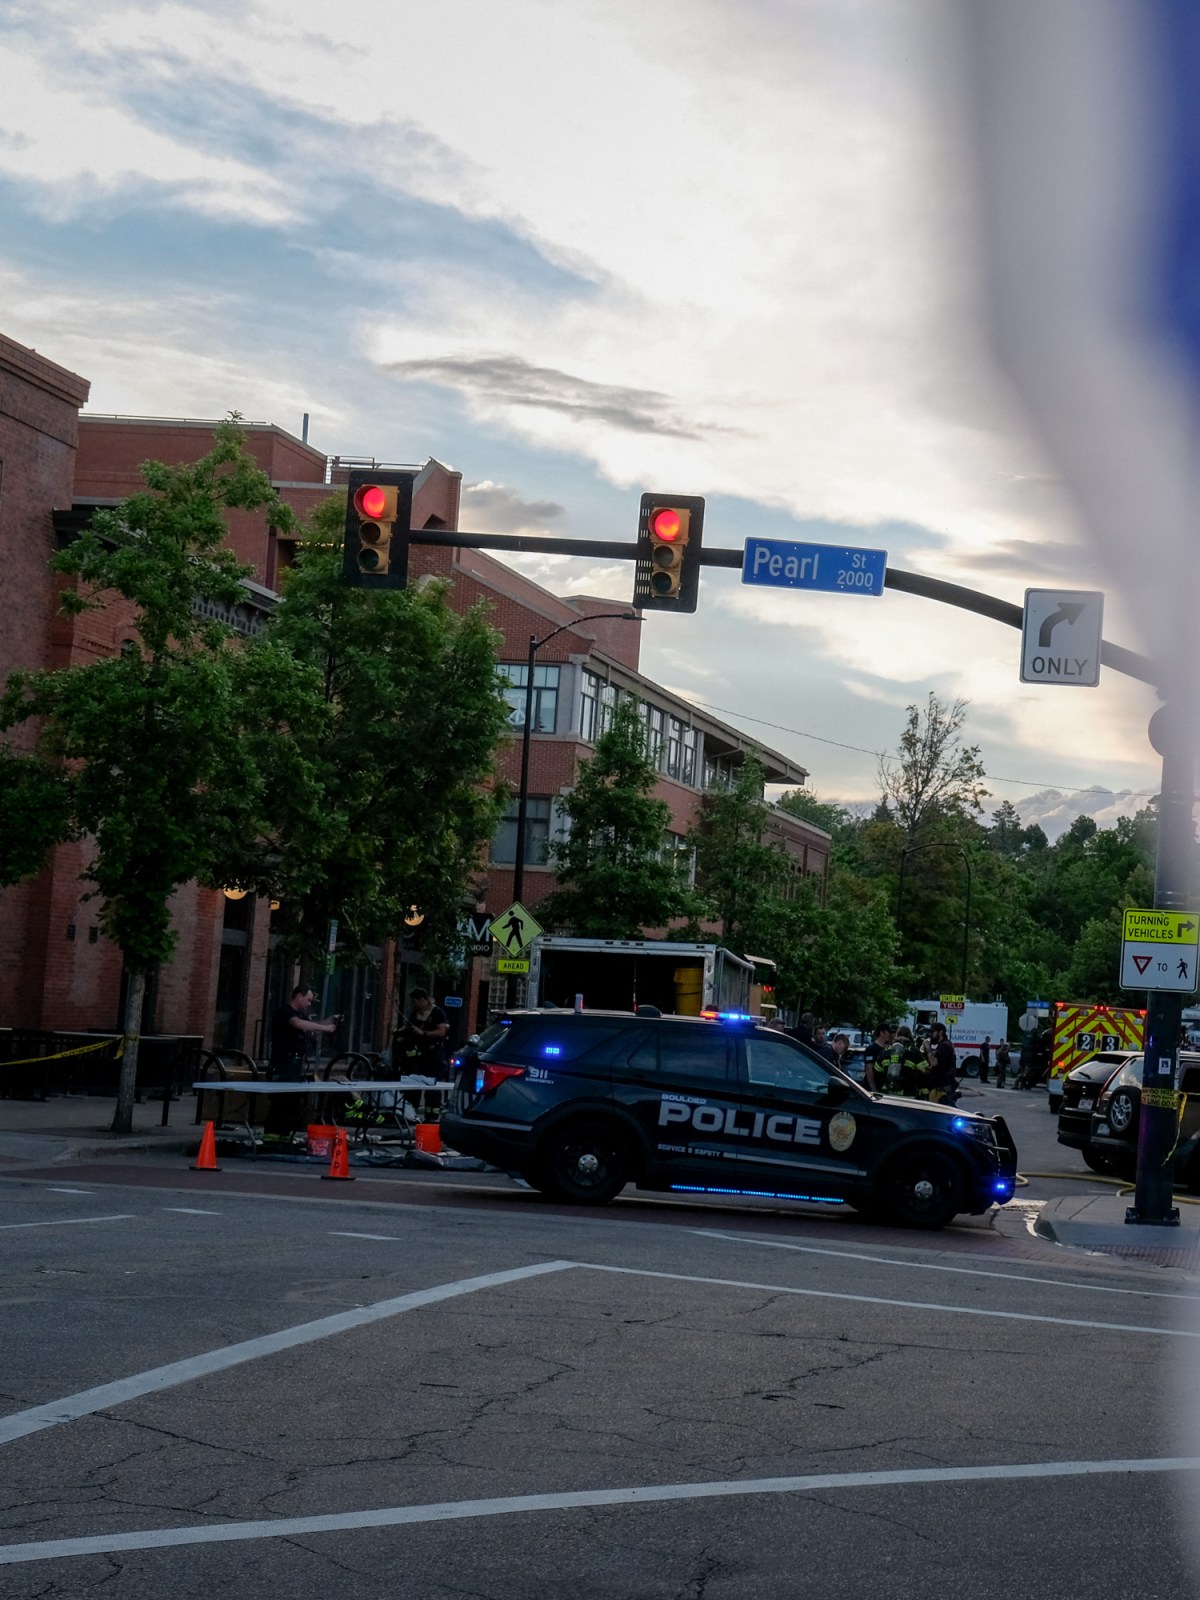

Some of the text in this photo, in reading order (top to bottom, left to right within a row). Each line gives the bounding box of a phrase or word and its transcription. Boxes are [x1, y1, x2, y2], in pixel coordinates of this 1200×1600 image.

[753, 547, 867, 580] Pearl St
[837, 570, 874, 587] 2000
[1032, 656, 1089, 676] ONLY
[1129, 915, 1170, 926] TURNING
[1128, 928, 1174, 939] VEHICLES
[503, 962, 524, 970] AHEAD
[1157, 963, 1168, 972] TO
[1081, 1034, 1116, 1051] 2 3
[529, 1067, 549, 1079] 911
[661, 1093, 707, 1105] BOULDER
[658, 1101, 822, 1146] POLICE
[657, 1143, 686, 1154] SERVICE
[694, 1148, 721, 1157] SAFETY
